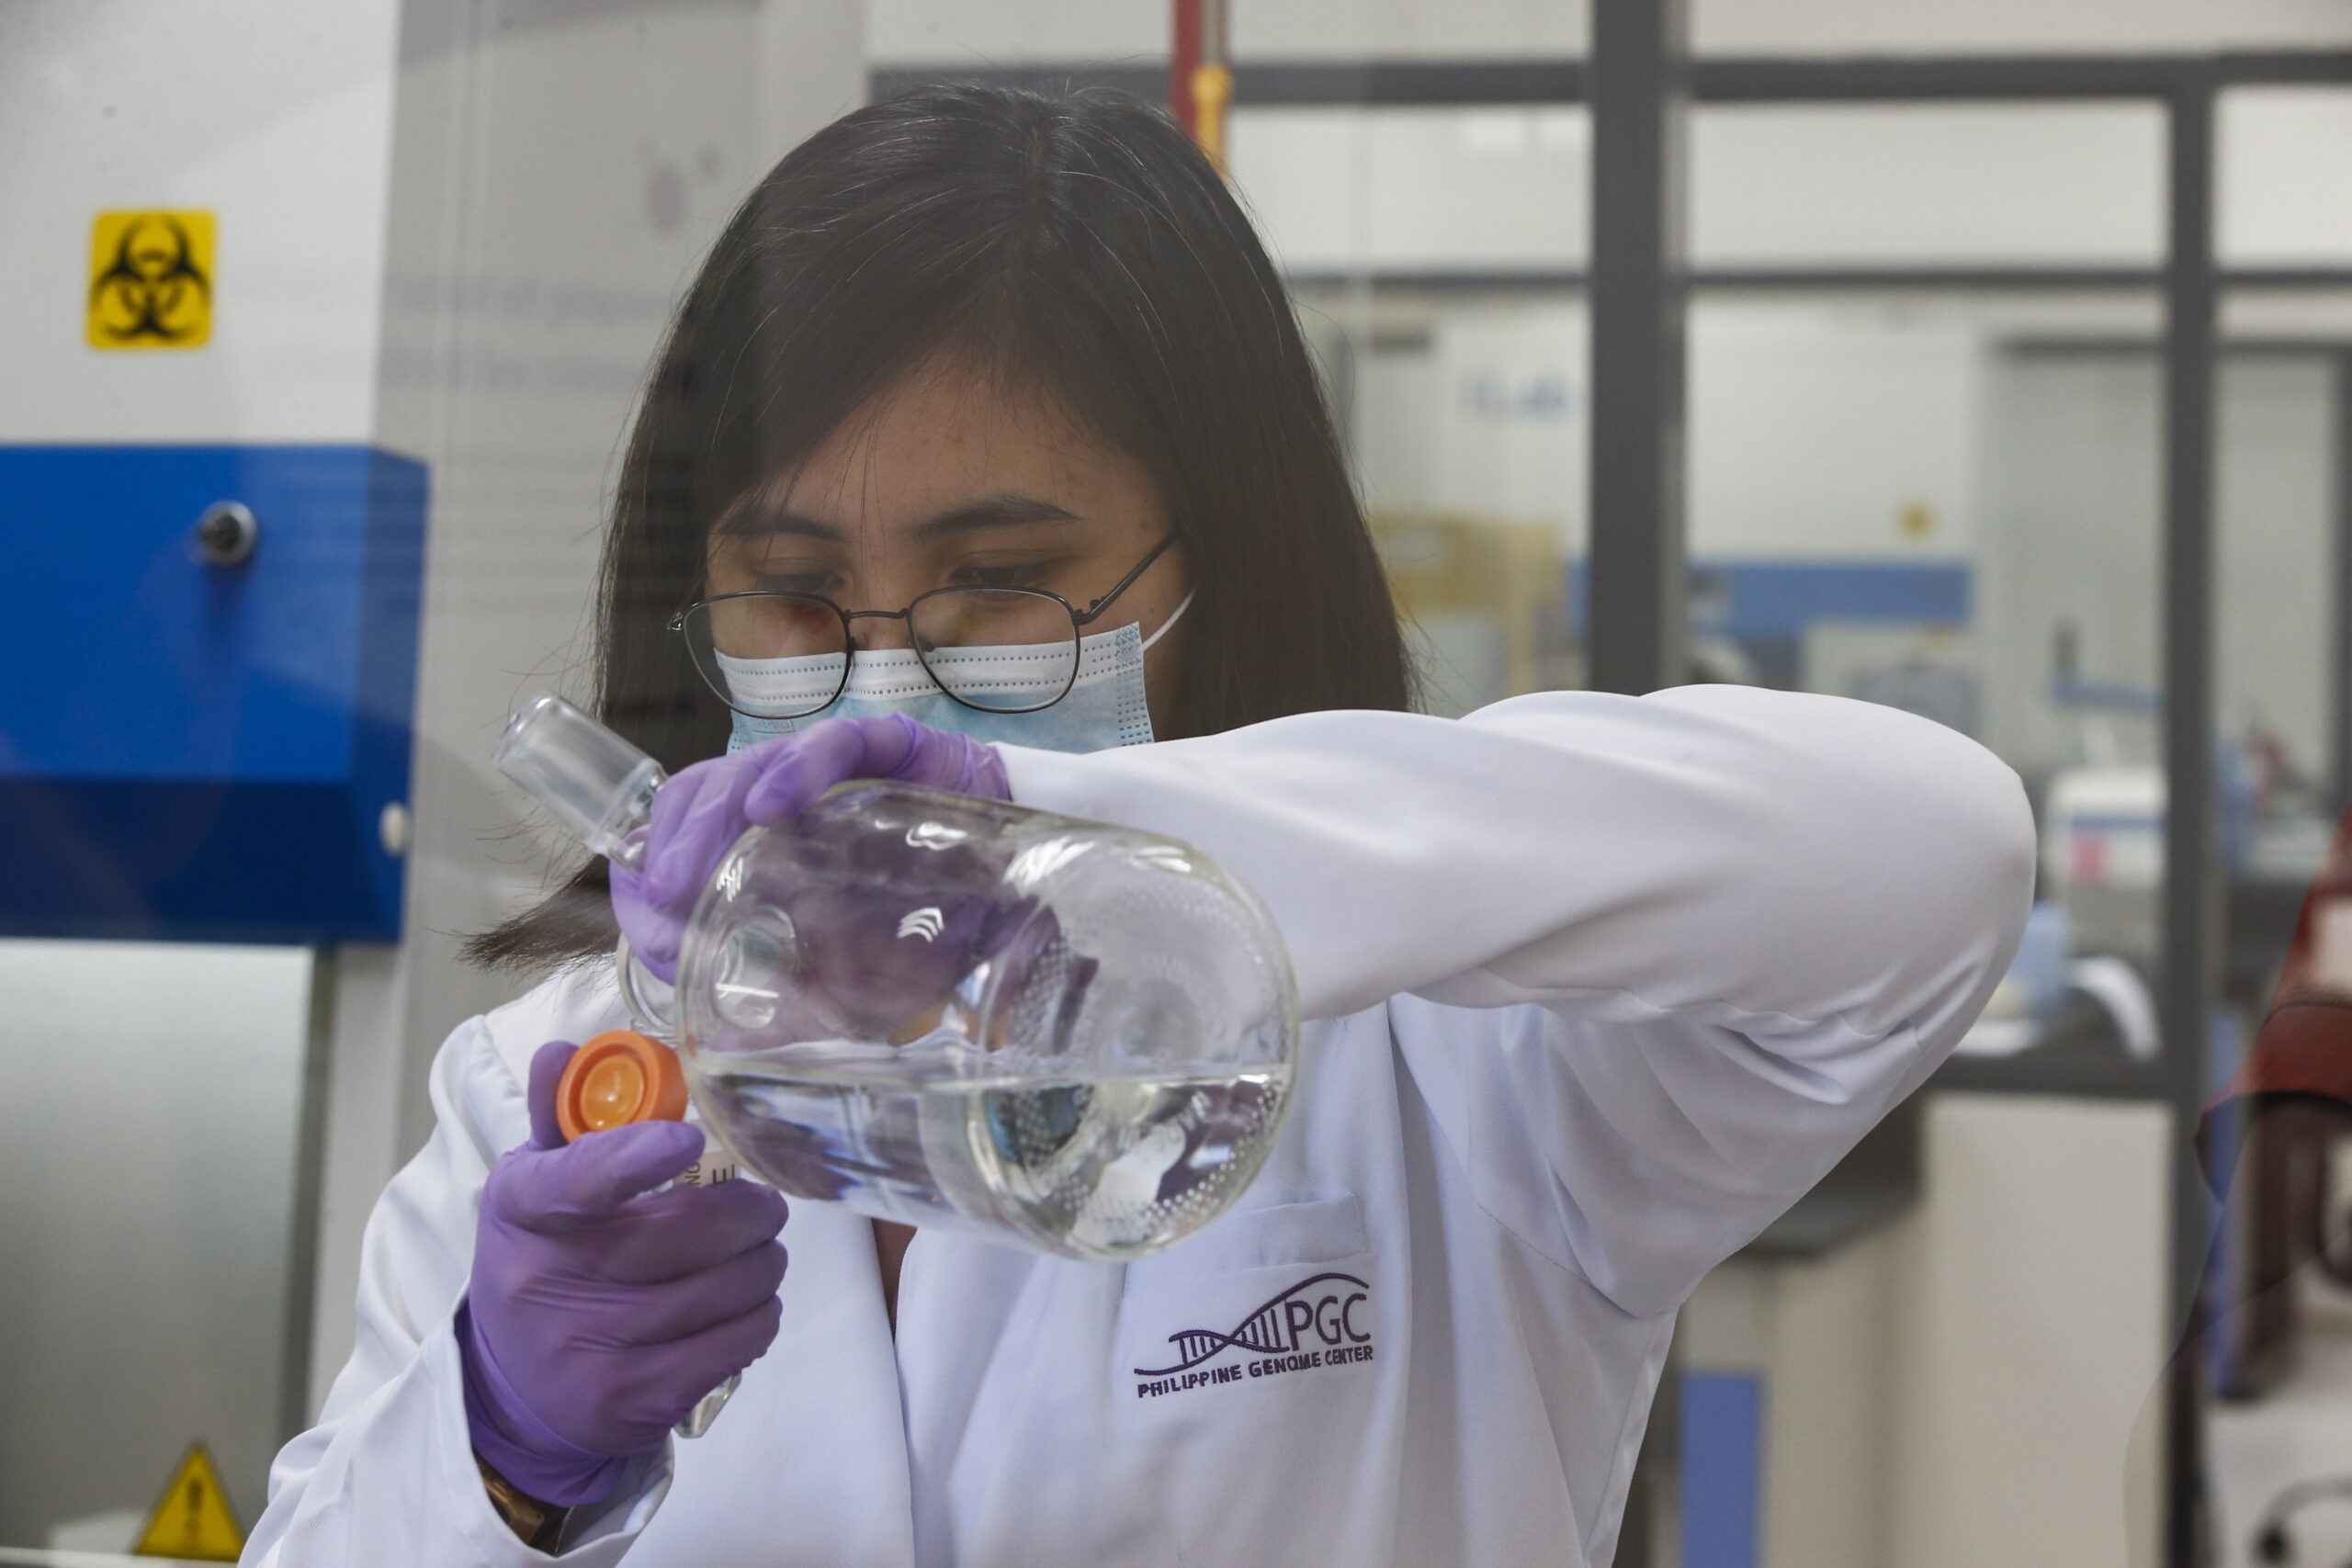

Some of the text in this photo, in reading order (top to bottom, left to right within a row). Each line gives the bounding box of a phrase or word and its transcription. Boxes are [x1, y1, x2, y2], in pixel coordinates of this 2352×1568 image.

[1285, 1292, 1371, 1351] PGC
[1137, 1345, 1374, 1399] PHILIPPINE GENOME CENTER
